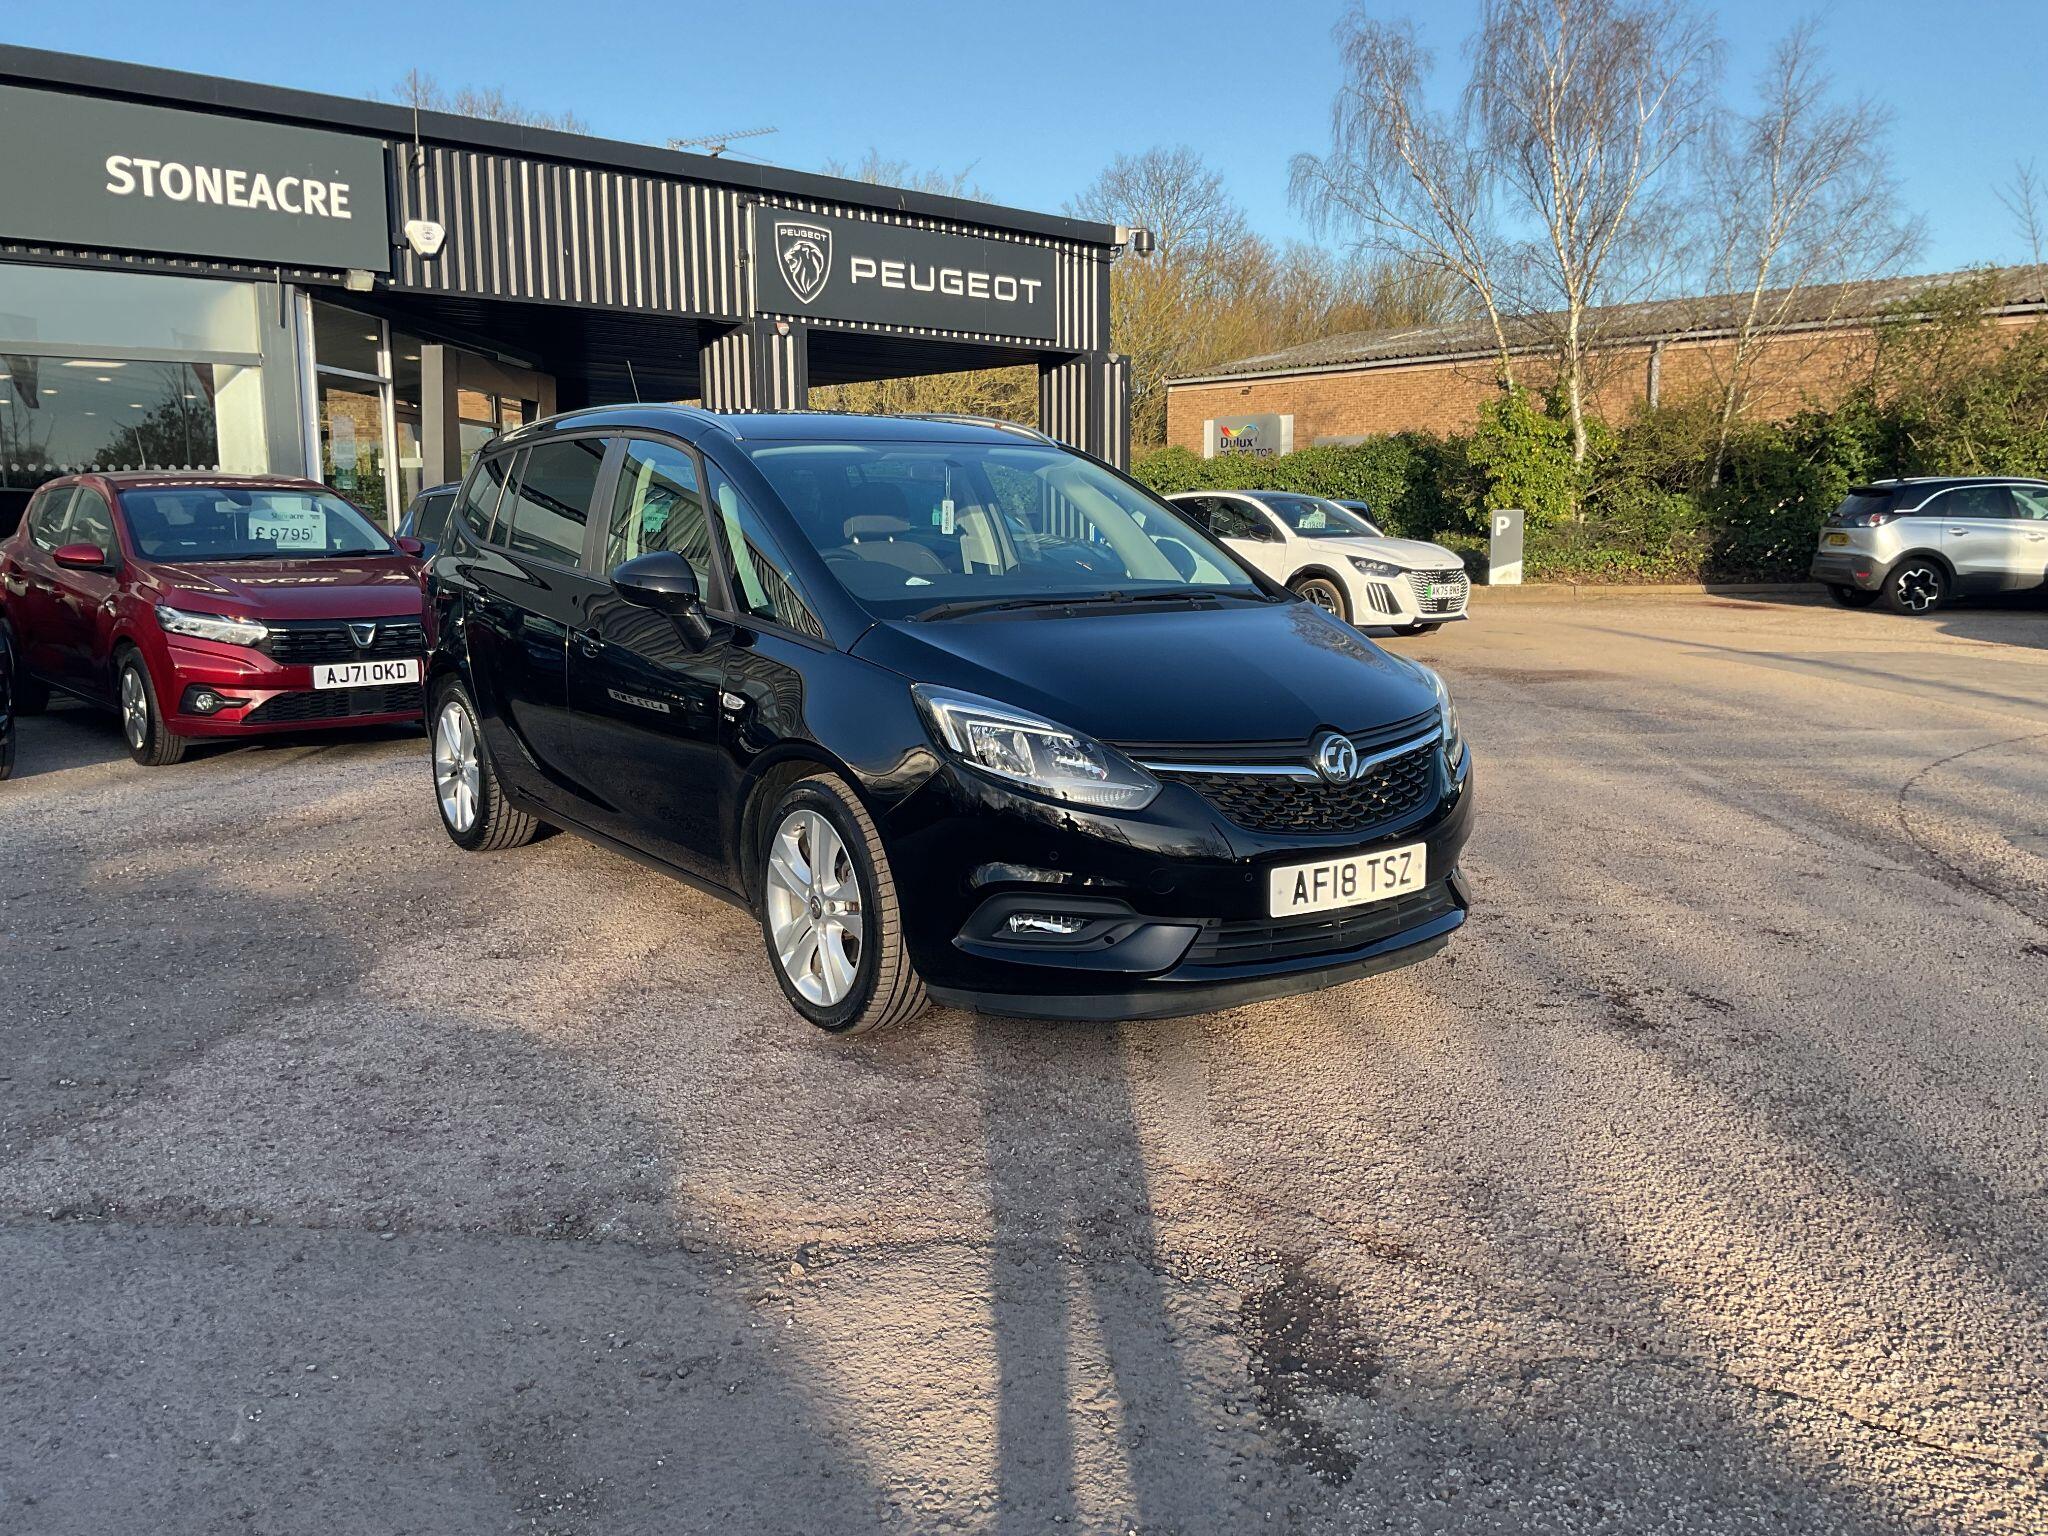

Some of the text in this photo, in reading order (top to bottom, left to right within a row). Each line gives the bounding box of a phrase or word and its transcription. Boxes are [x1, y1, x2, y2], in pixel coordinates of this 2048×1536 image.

[105, 155, 352, 219] STONEACRE
[780, 228, 827, 241] PEUGEOT
[851, 257, 1042, 304] PEUGEOT
[1220, 437, 1254, 449] Dulux
[1496, 516, 1511, 536] P
[327, 662, 407, 684] AJ71 OKD
[1292, 852, 1412, 905] AF18 TSZ
